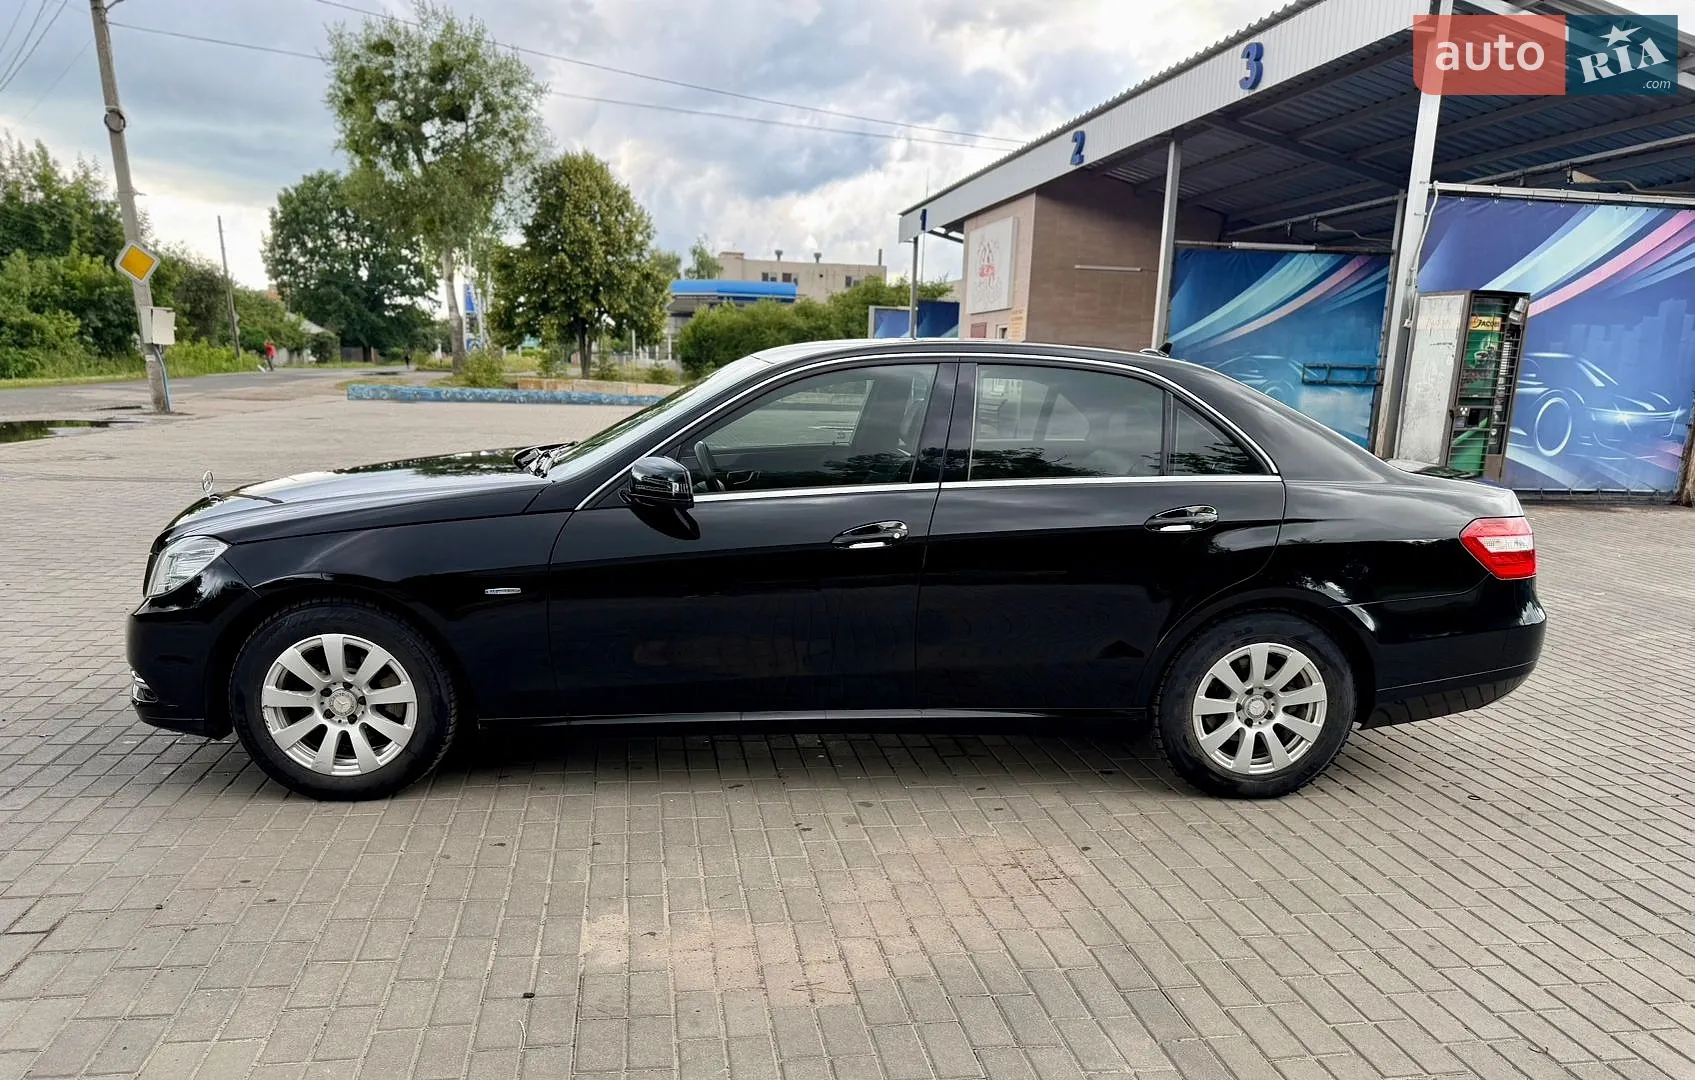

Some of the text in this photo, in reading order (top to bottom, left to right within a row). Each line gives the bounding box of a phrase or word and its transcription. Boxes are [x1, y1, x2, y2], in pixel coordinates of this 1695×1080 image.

[1239, 42, 1264, 90] 3
[1070, 130, 1086, 166] 2
[920, 208, 927, 231] 1
